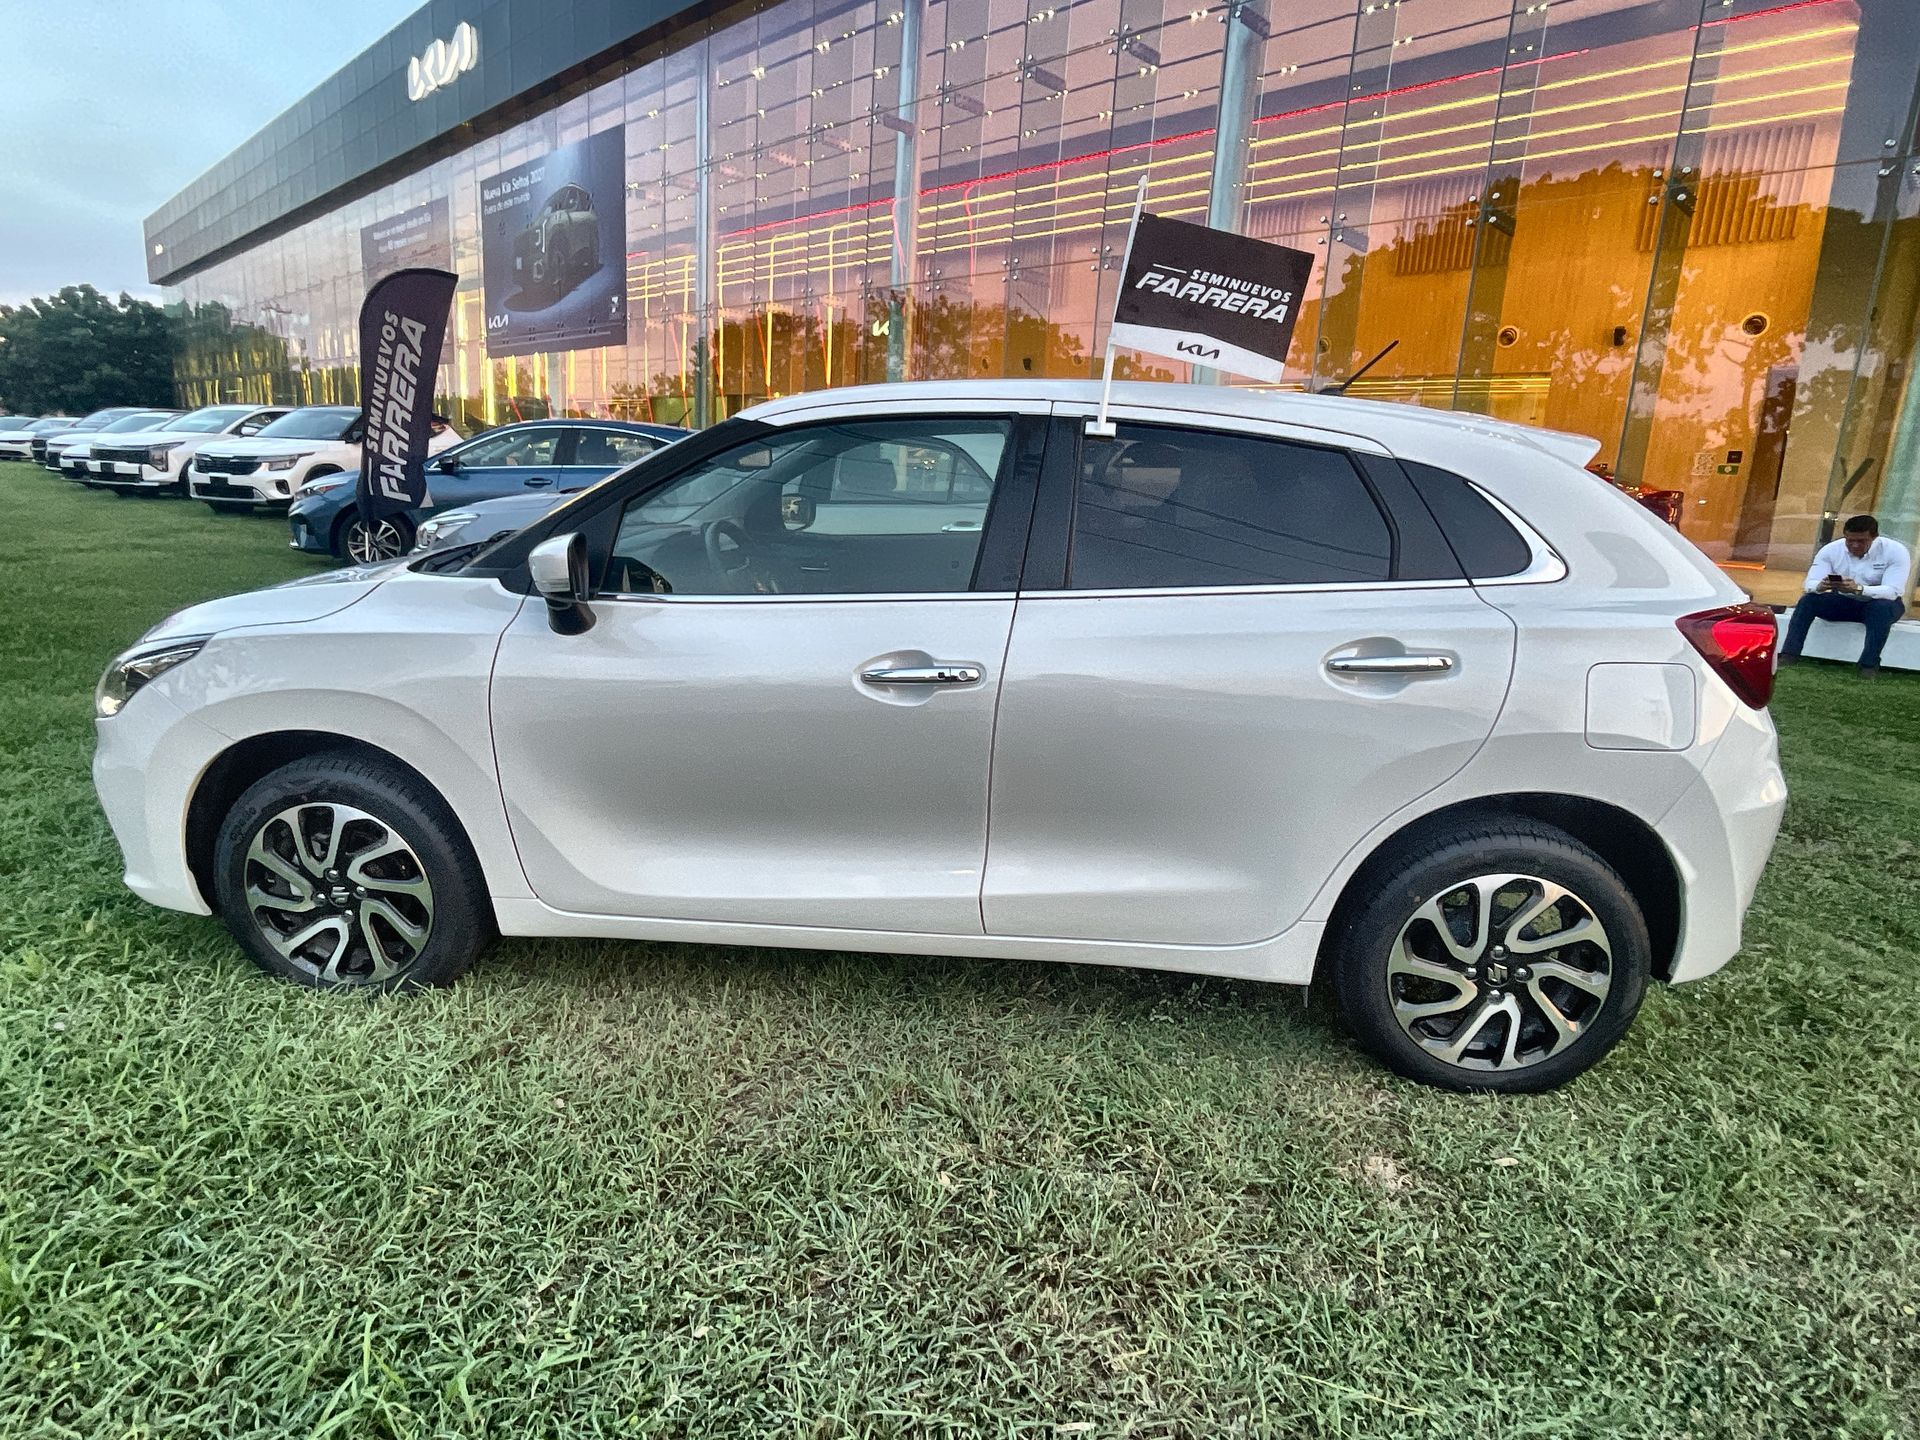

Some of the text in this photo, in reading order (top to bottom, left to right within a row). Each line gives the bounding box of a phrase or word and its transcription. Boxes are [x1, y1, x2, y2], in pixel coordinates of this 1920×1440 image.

[1136, 271, 1289, 324] FARRERA
[1191, 269, 1292, 302] SEMINUEVOS
[1177, 341, 1220, 359] KIA
[366, 310, 400, 454] SEMINUEVOS
[380, 316, 427, 503] FARRERA
